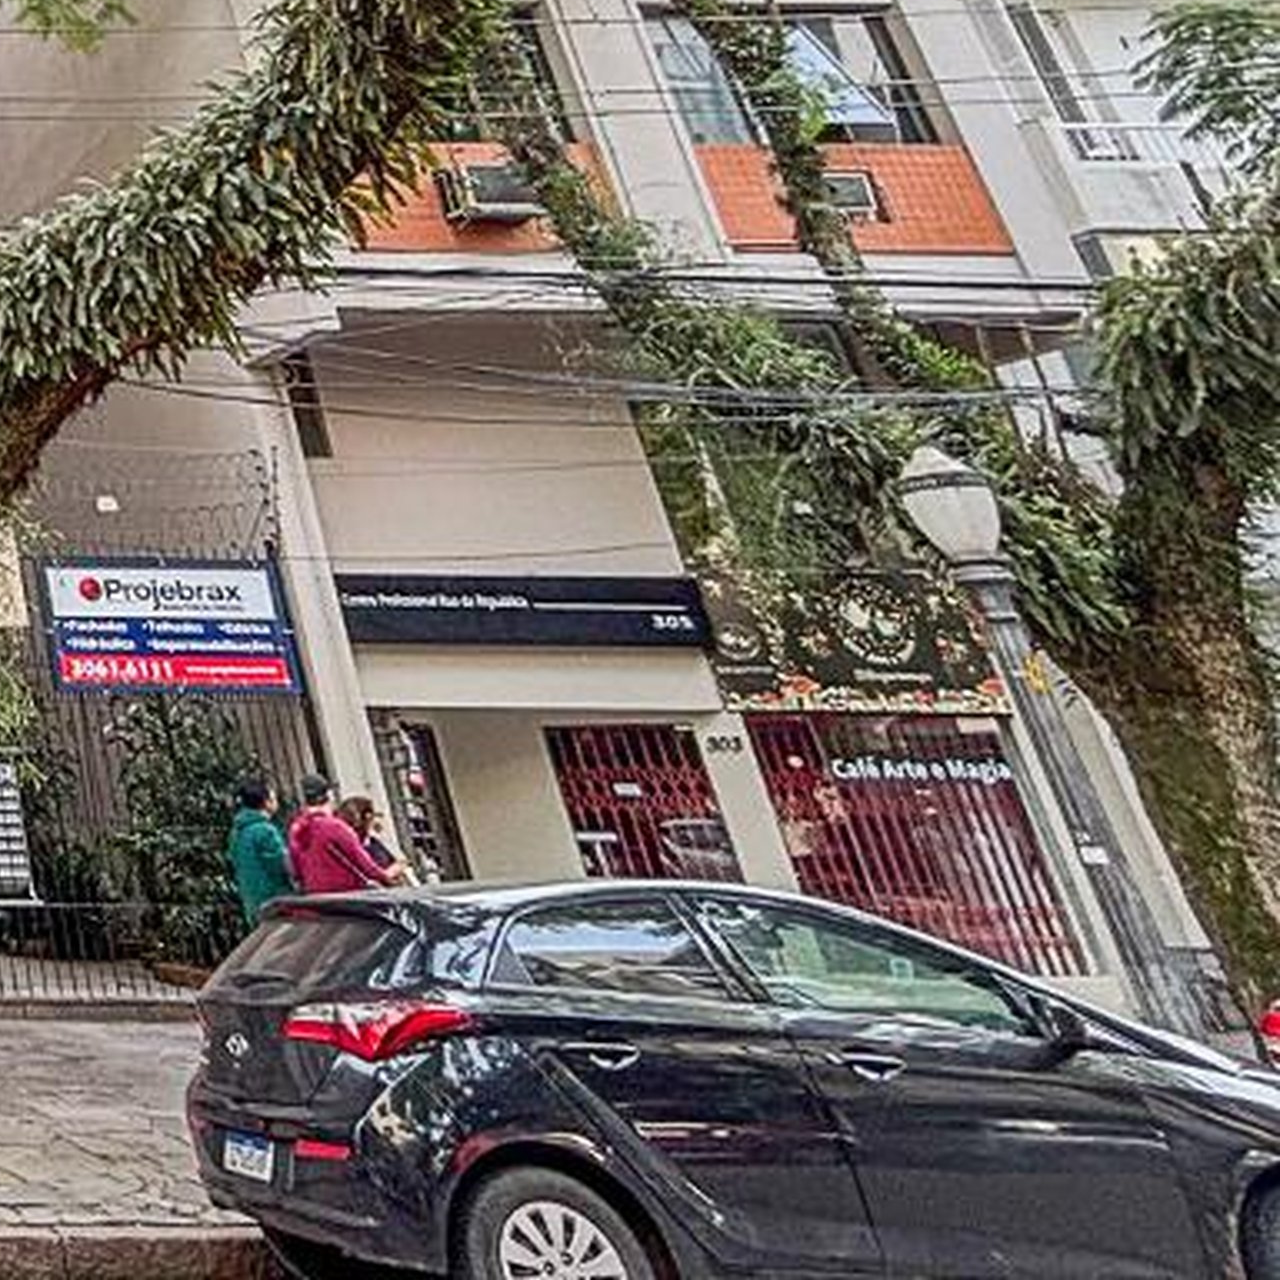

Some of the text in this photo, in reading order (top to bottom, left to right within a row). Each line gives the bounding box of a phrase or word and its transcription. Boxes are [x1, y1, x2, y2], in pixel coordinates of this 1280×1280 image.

[104, 578, 242, 610] Projebrax
[832, 756, 1012, 785] Café Arte e Magia
